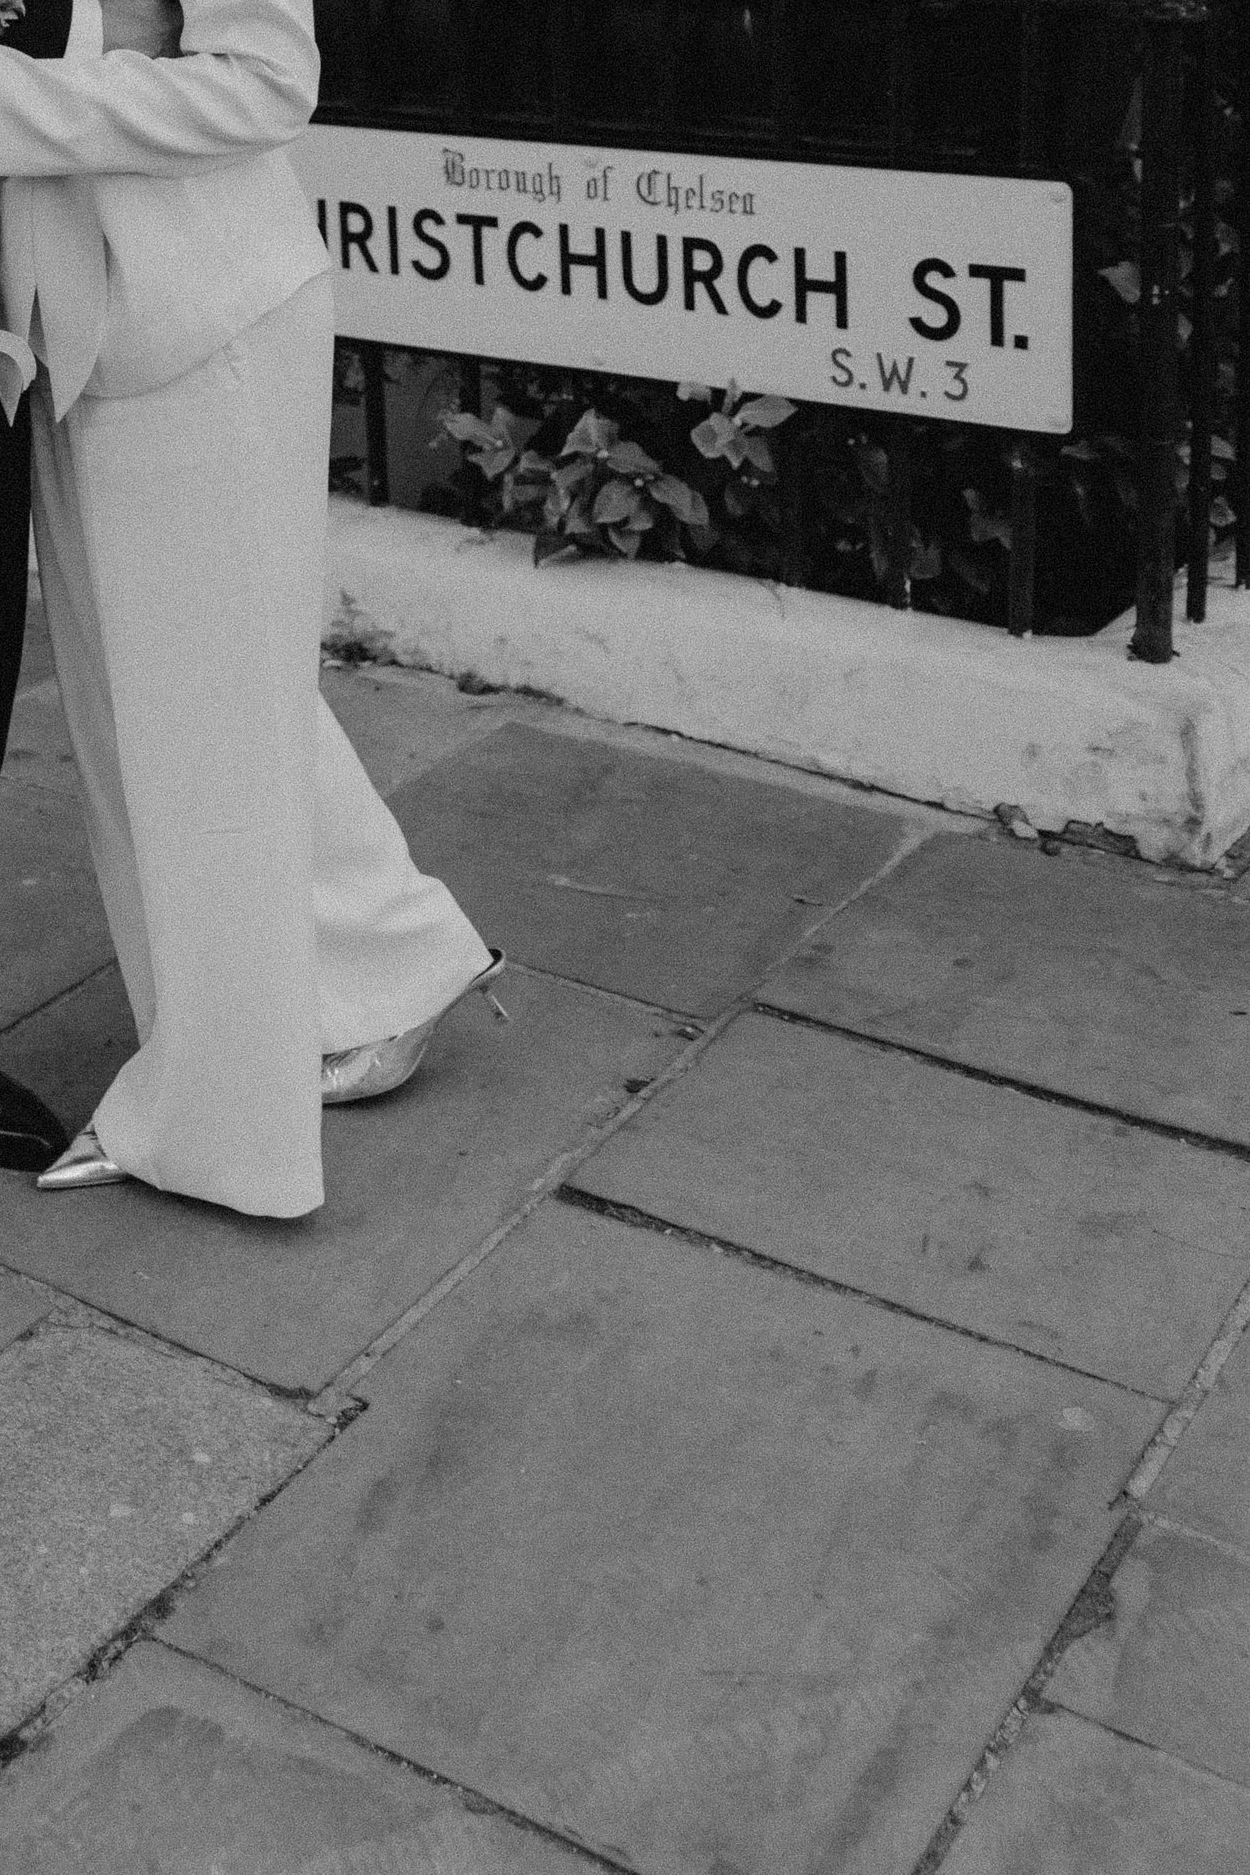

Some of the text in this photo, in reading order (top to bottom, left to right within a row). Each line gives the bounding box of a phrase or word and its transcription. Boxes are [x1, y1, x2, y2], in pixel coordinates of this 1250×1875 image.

[443, 147, 756, 216] Borough of Chelsea
[317, 199, 1029, 351] RISTCHURCH ST.
[830, 347, 969, 401] S.W. 3
